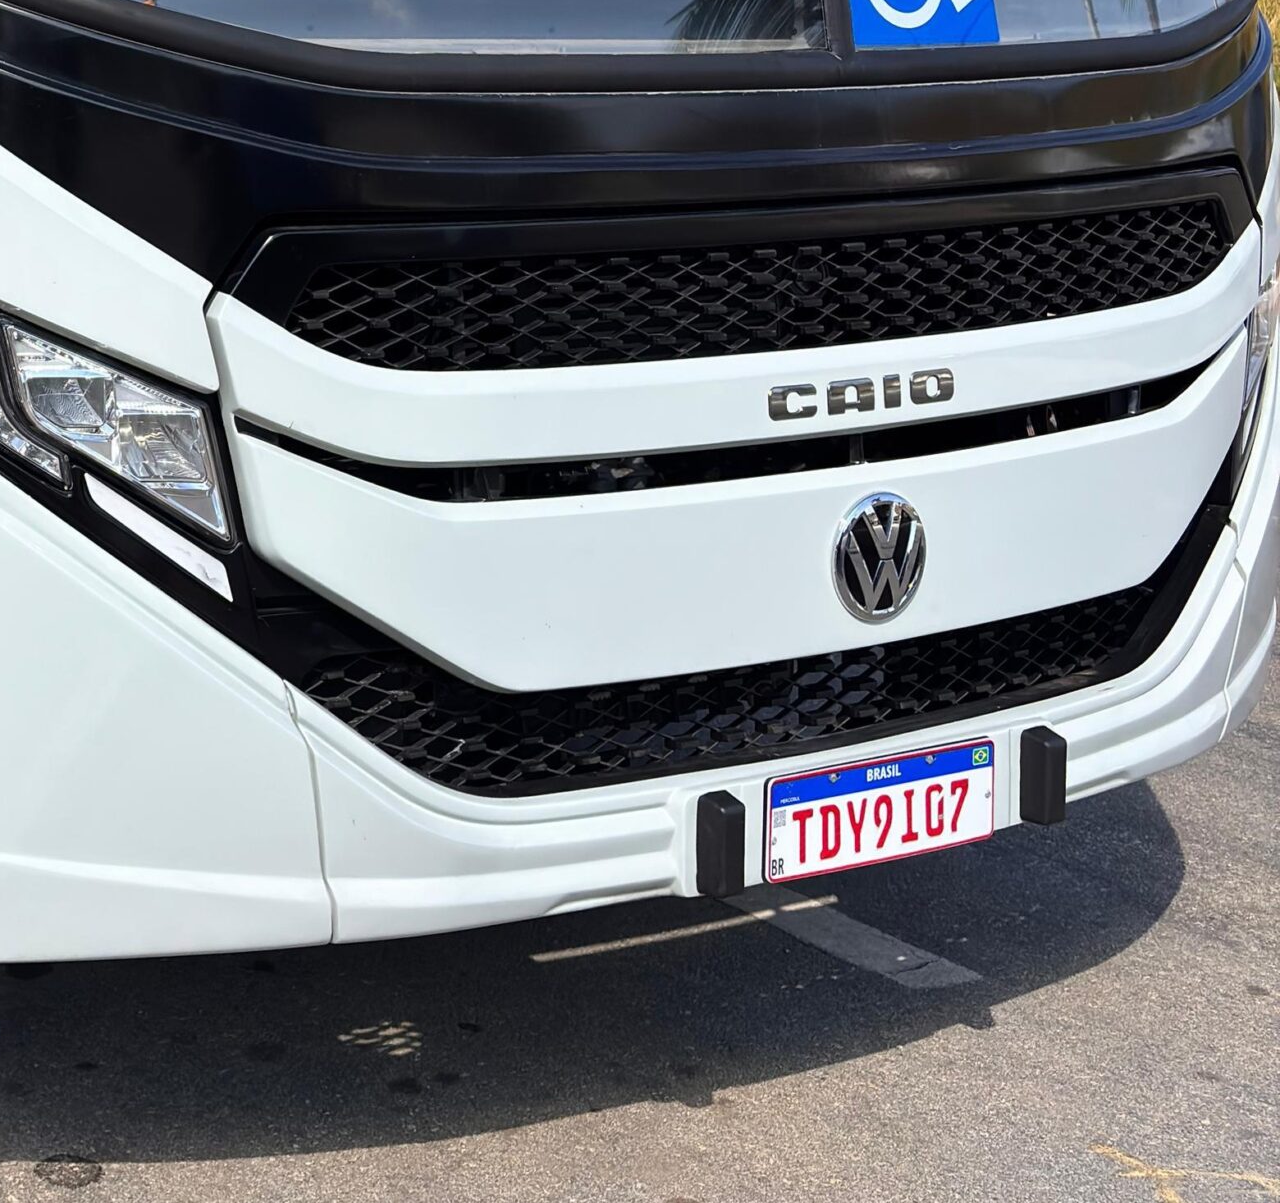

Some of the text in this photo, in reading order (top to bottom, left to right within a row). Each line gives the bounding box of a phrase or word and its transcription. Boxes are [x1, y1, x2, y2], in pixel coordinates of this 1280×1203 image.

[768, 367, 955, 421] CAIO
[866, 763, 902, 782] BRASIL
[771, 859, 785, 877] BR
